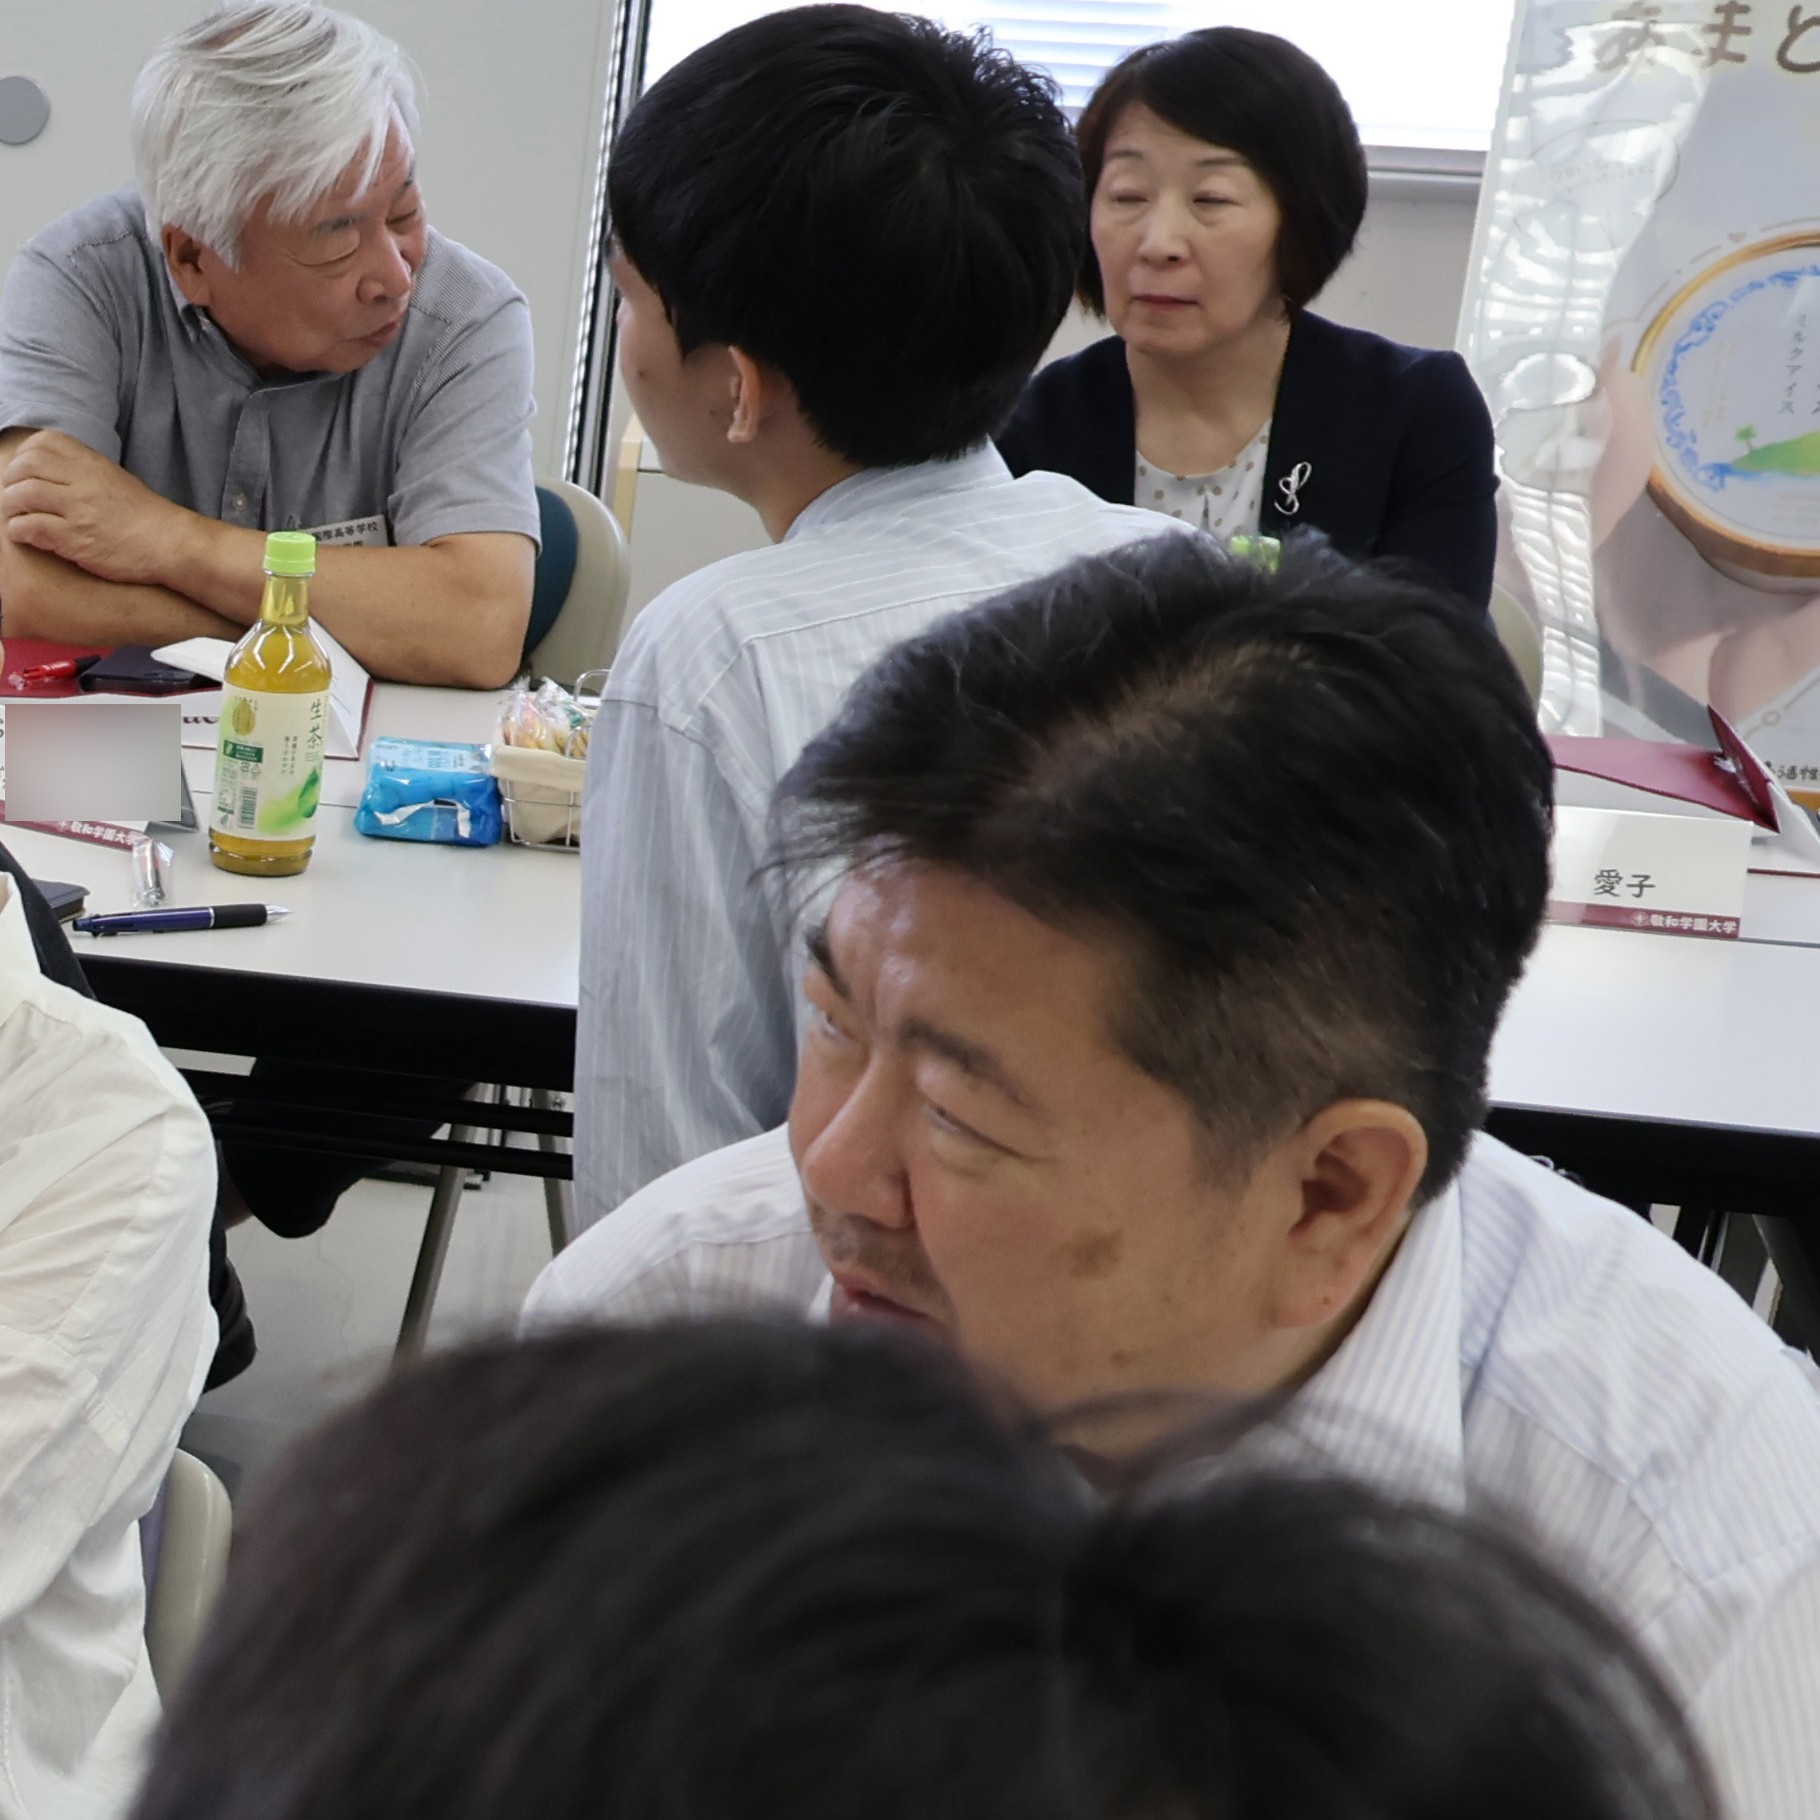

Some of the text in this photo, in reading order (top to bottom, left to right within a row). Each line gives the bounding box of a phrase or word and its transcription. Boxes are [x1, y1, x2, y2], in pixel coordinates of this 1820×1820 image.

[70, 821, 142, 846] 敬和学園大学
[1593, 869, 1656, 899] 愛子
[1650, 914, 1738, 934] 敬和学園大学
